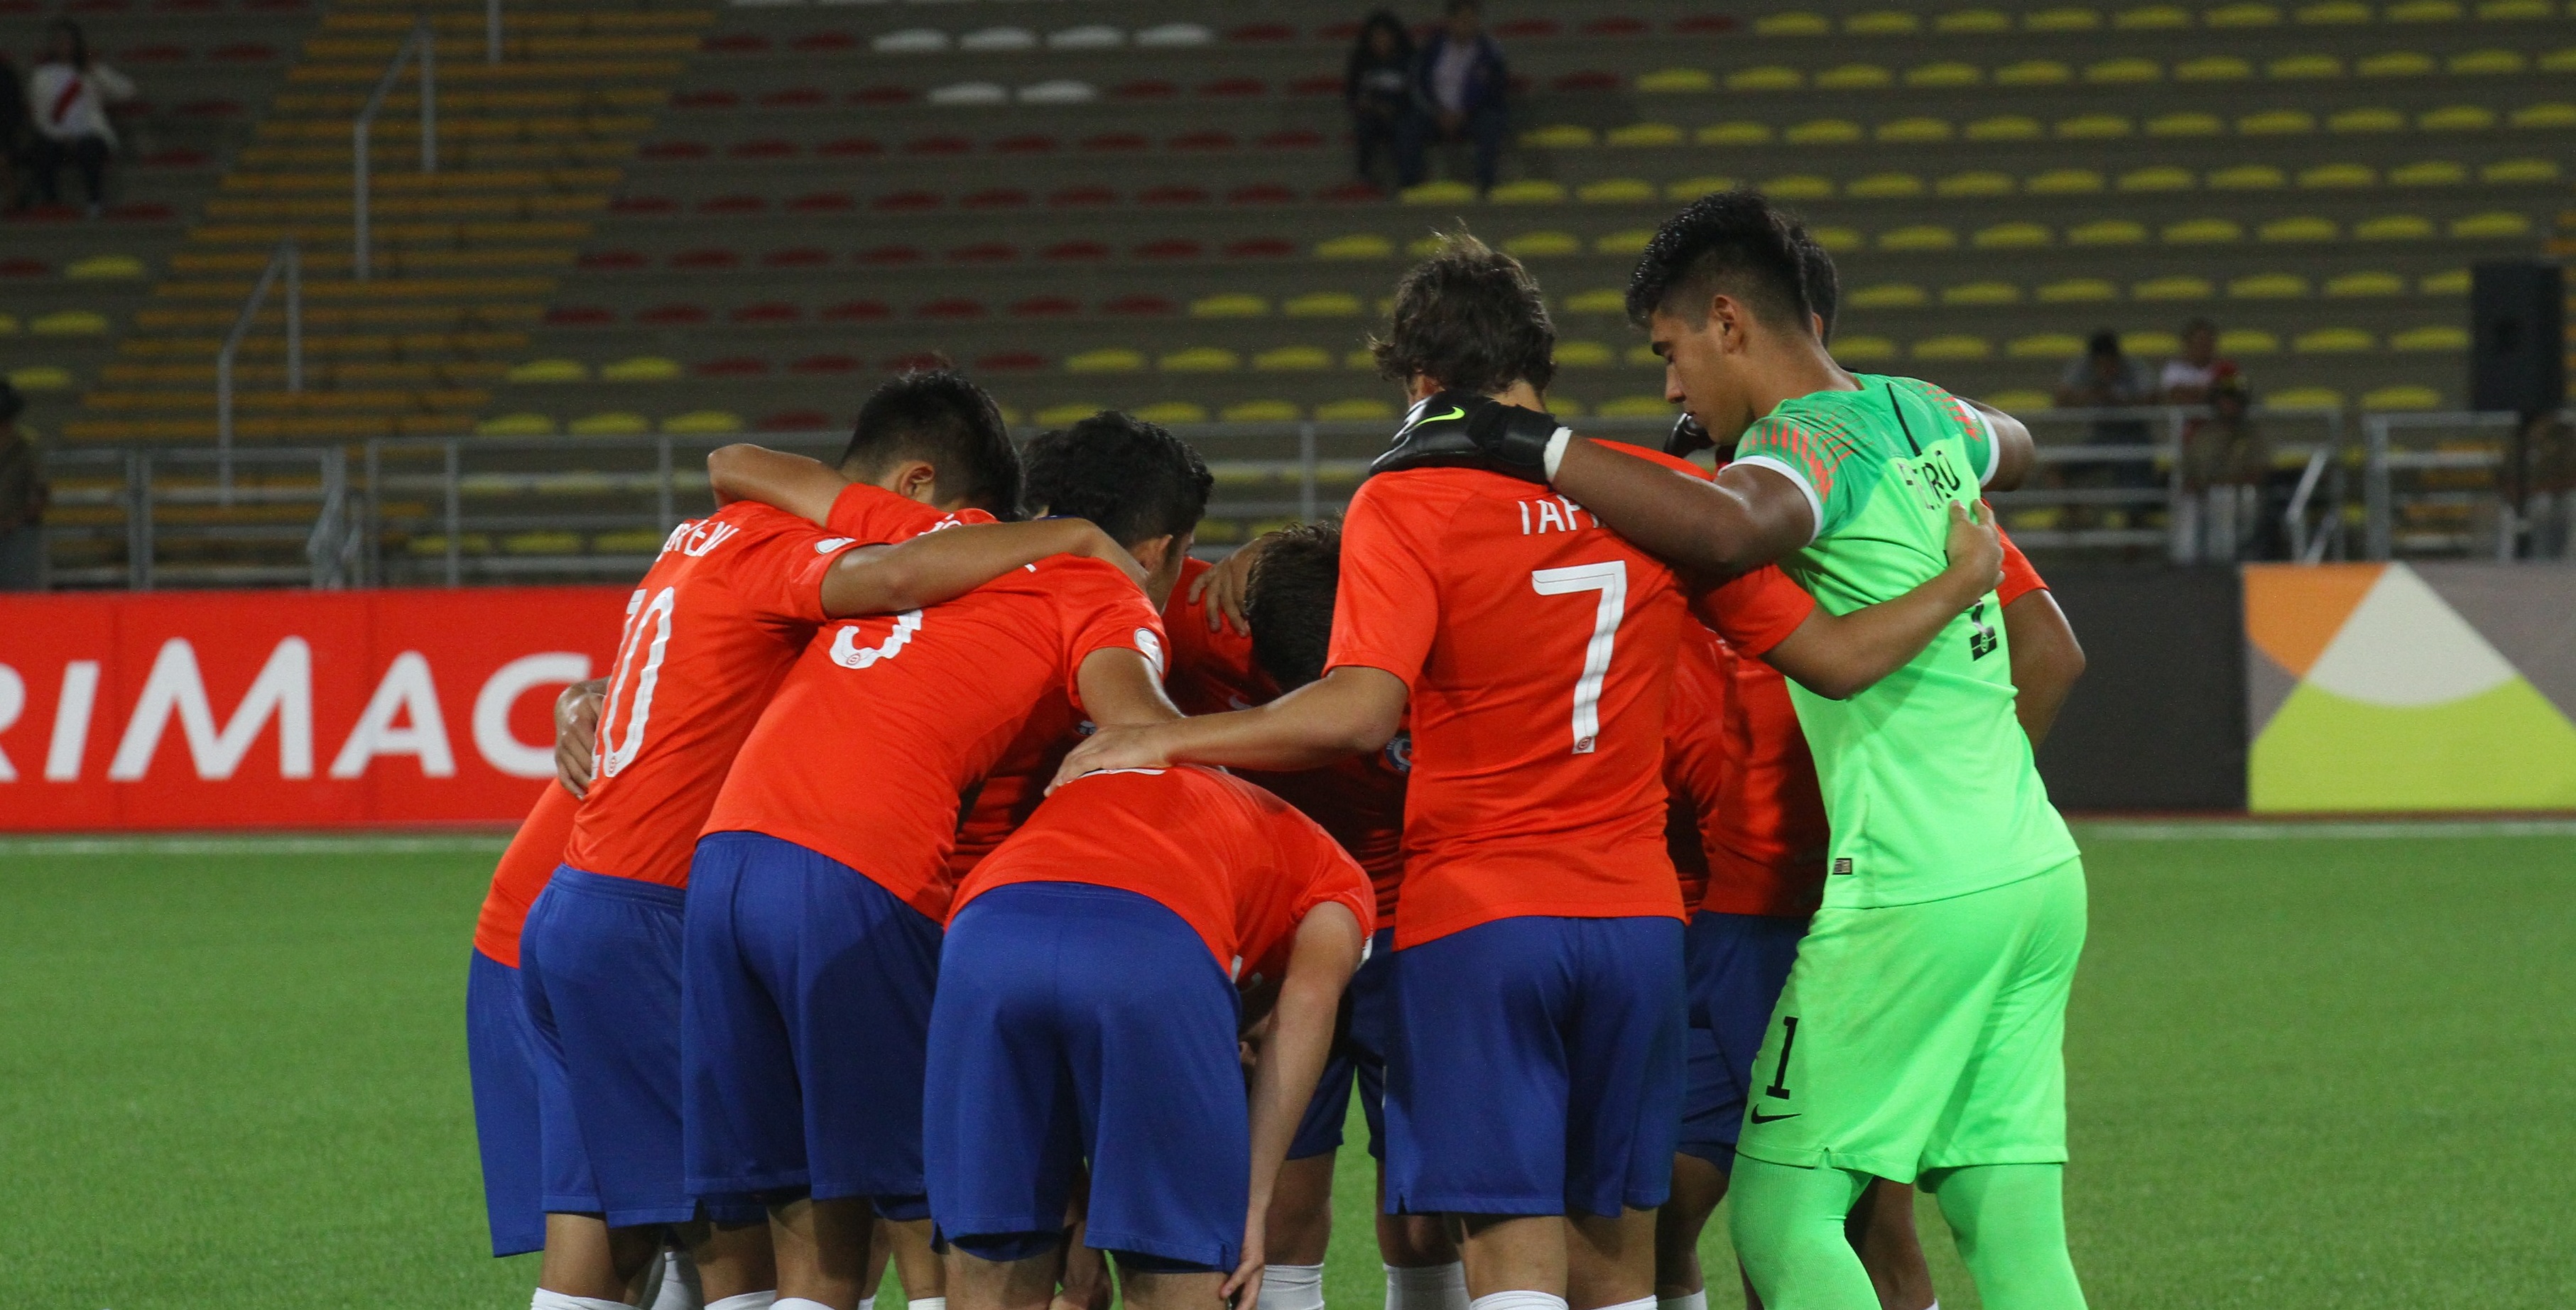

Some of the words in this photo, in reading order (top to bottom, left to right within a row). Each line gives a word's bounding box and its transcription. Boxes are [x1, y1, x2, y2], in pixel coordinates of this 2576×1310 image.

[591, 586, 675, 780] 10
[1531, 560, 1627, 753] 7
[1766, 1016, 1799, 1100] 1
